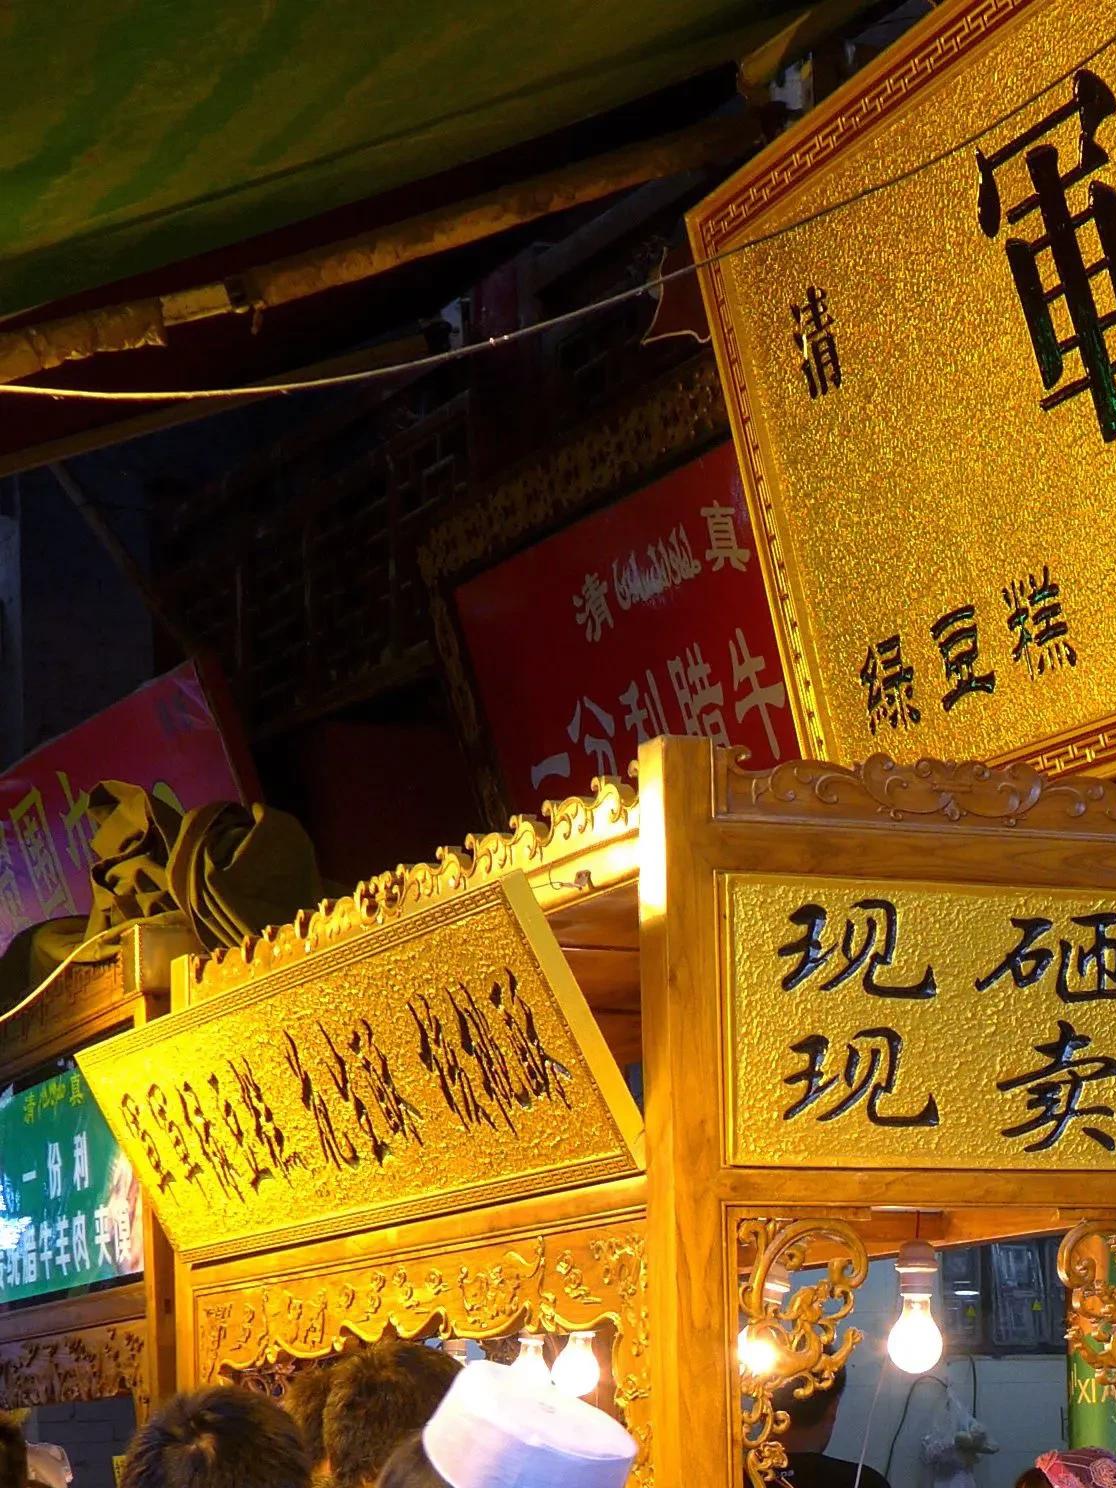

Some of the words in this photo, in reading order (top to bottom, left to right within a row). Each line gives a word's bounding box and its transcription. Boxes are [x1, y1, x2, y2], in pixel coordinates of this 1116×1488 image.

[790, 286, 842, 400] 清
[573, 573, 613, 643] 清
[700, 501, 751, 573] 真
[22, 1131, 89, 1199] 一份利
